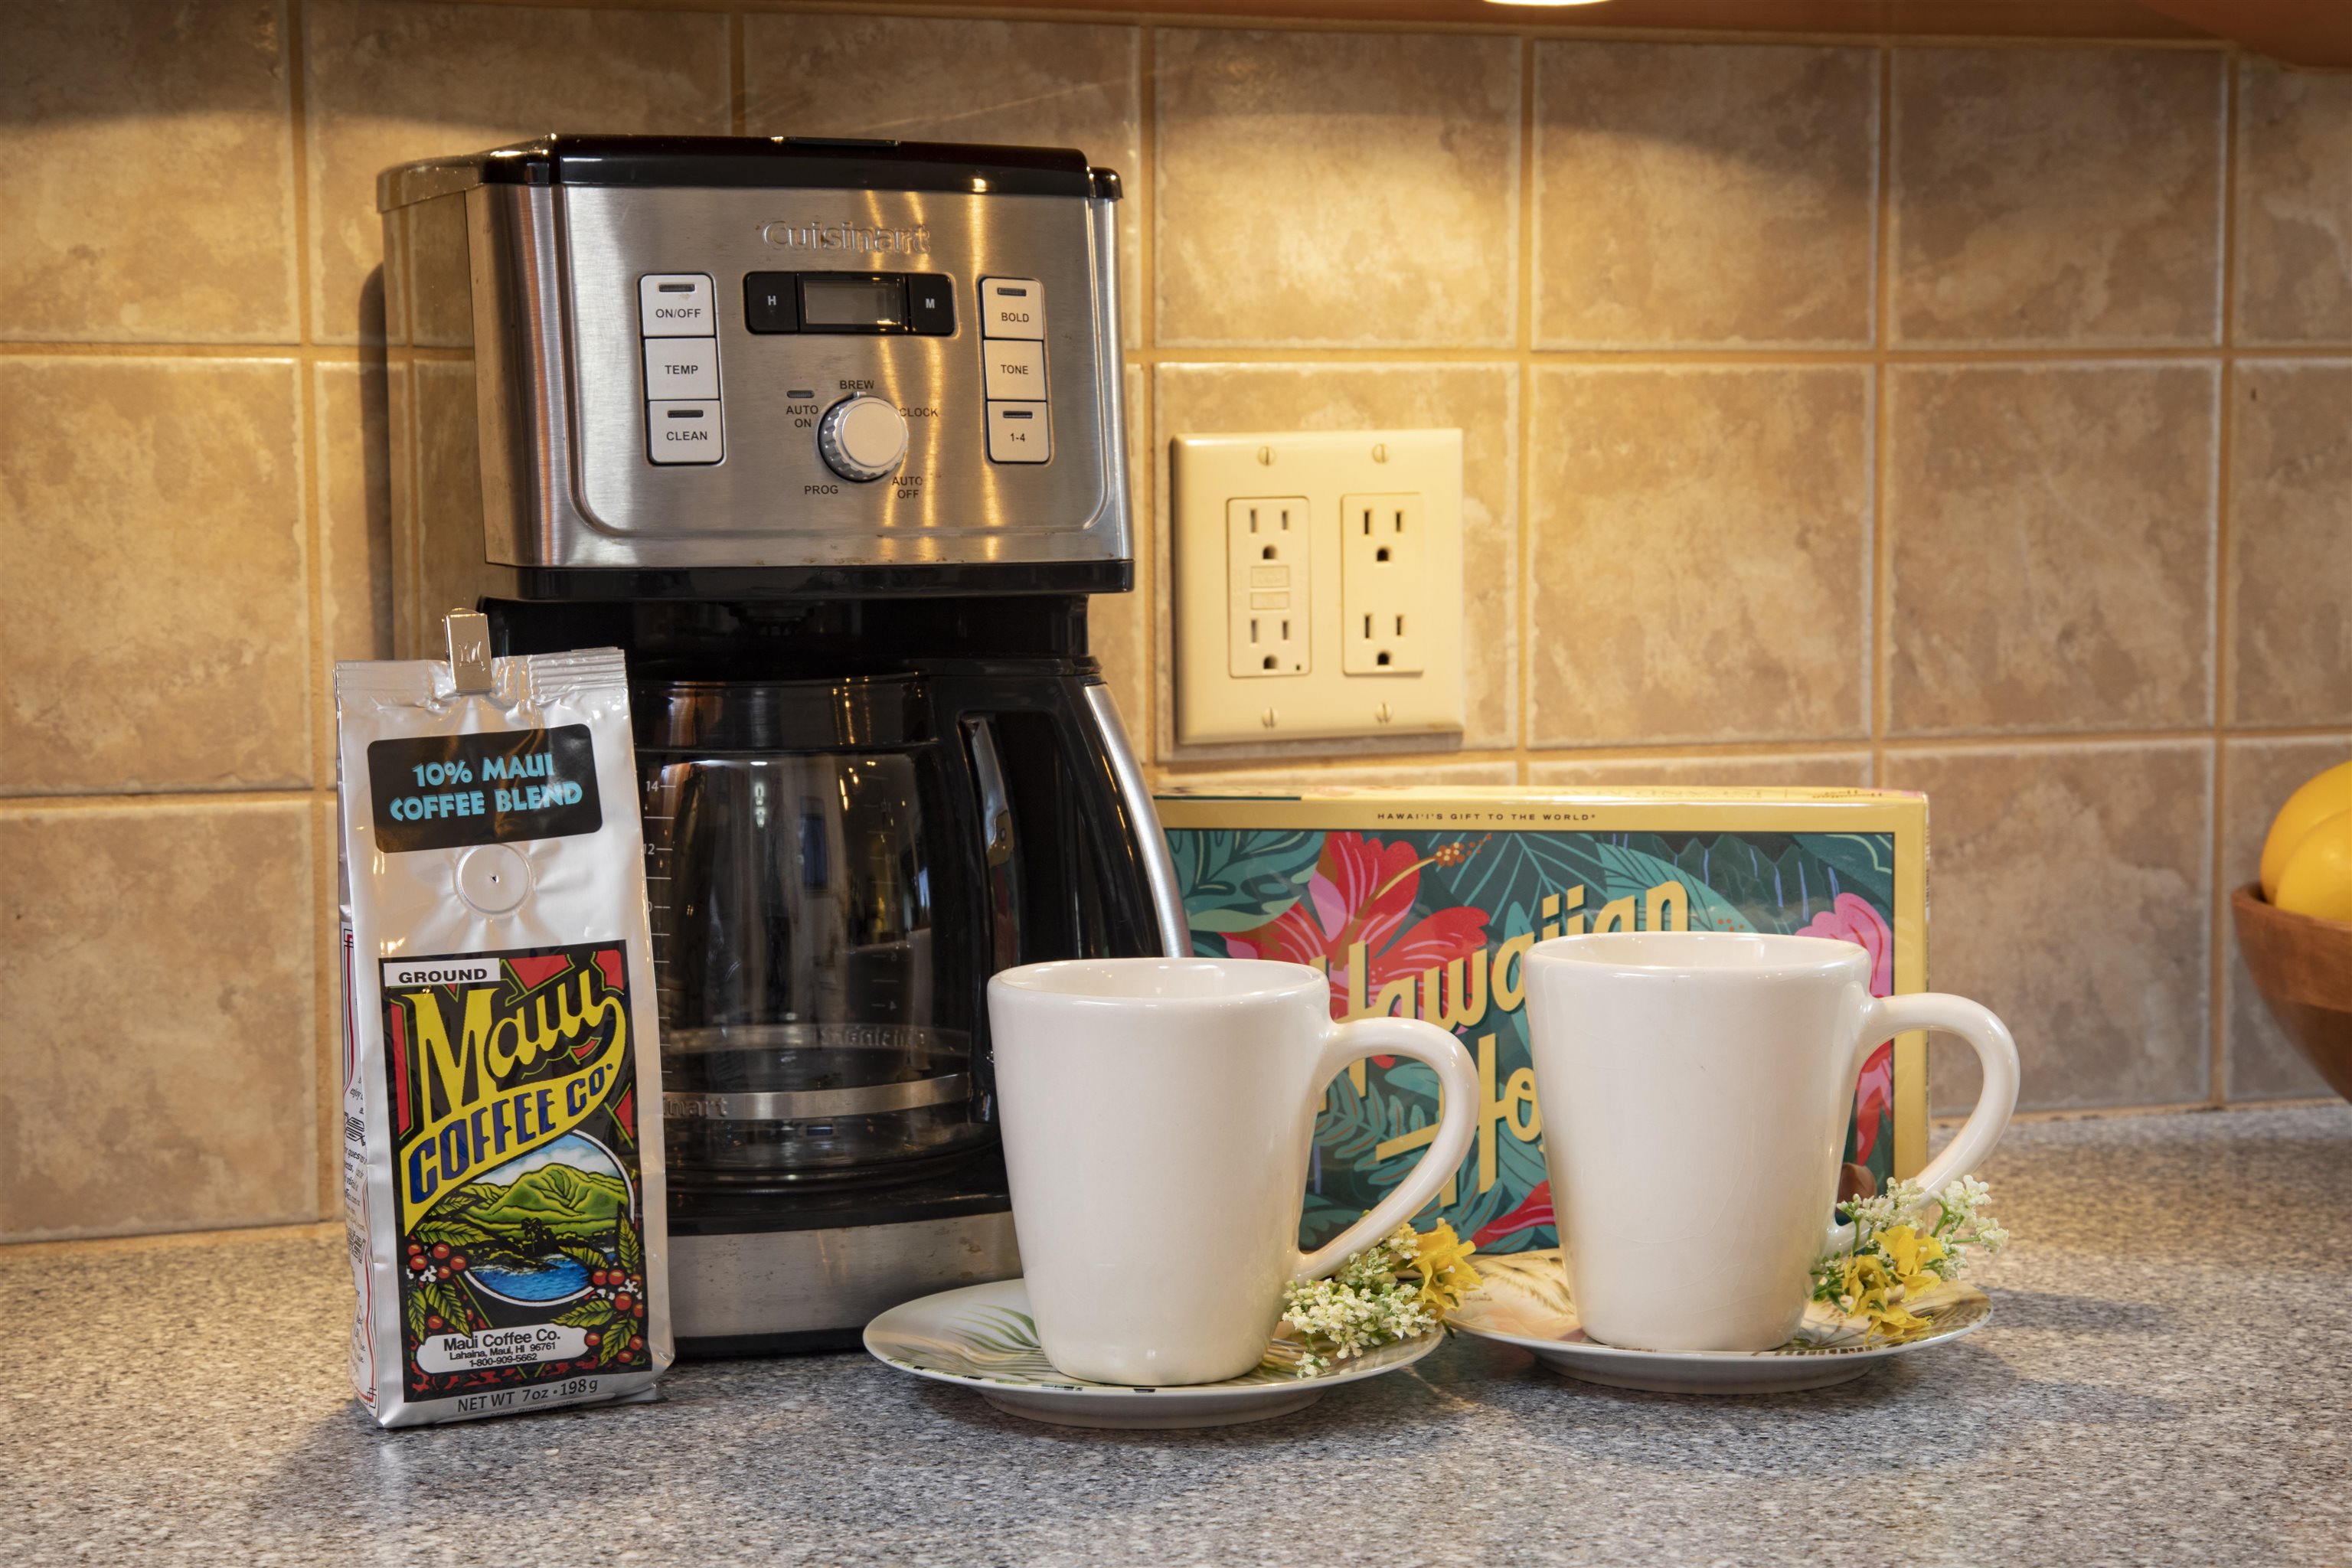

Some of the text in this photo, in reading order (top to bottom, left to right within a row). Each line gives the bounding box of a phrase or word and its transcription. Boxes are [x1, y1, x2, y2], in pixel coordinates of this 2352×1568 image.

[763, 220, 931, 254] Cuisinart
[768, 296, 776, 305] H
[926, 299, 935, 309] M
[655, 307, 701, 319] ON/OFF
[1001, 312, 1030, 323] BOLD
[665, 364, 699, 375] TEMP
[1001, 364, 1029, 375] TONE
[839, 380, 874, 390] BREW
[786, 404, 818, 416] AUTO
[899, 407, 939, 418] CLOCK
[794, 418, 812, 429] ON
[666, 430, 707, 442] CLEAN
[1010, 432, 1026, 443] 1-4
[892, 476, 923, 487] AUTO
[804, 484, 839, 495] PROG
[897, 488, 920, 499] OFF
[413, 752, 555, 787] 10% MAUI
[645, 780, 658, 792] 14
[390, 780, 583, 822] COFFEE BLEND
[398, 967, 488, 984] GROUND
[400, 969, 626, 1135] Maui
[408, 1088, 556, 1204] COFFEE
[443, 1328, 560, 1351] Maui Coffee Co.
[449, 1348, 488, 1361] Lahaina,
[490, 1346, 512, 1357] Maui,
[530, 1342, 556, 1352] 96761
[469, 1354, 537, 1367] 1-800-909-5662
[458, 1396, 488, 1413] NET
[491, 1391, 515, 1407] WT
[522, 1387, 548, 1403] 7oz
